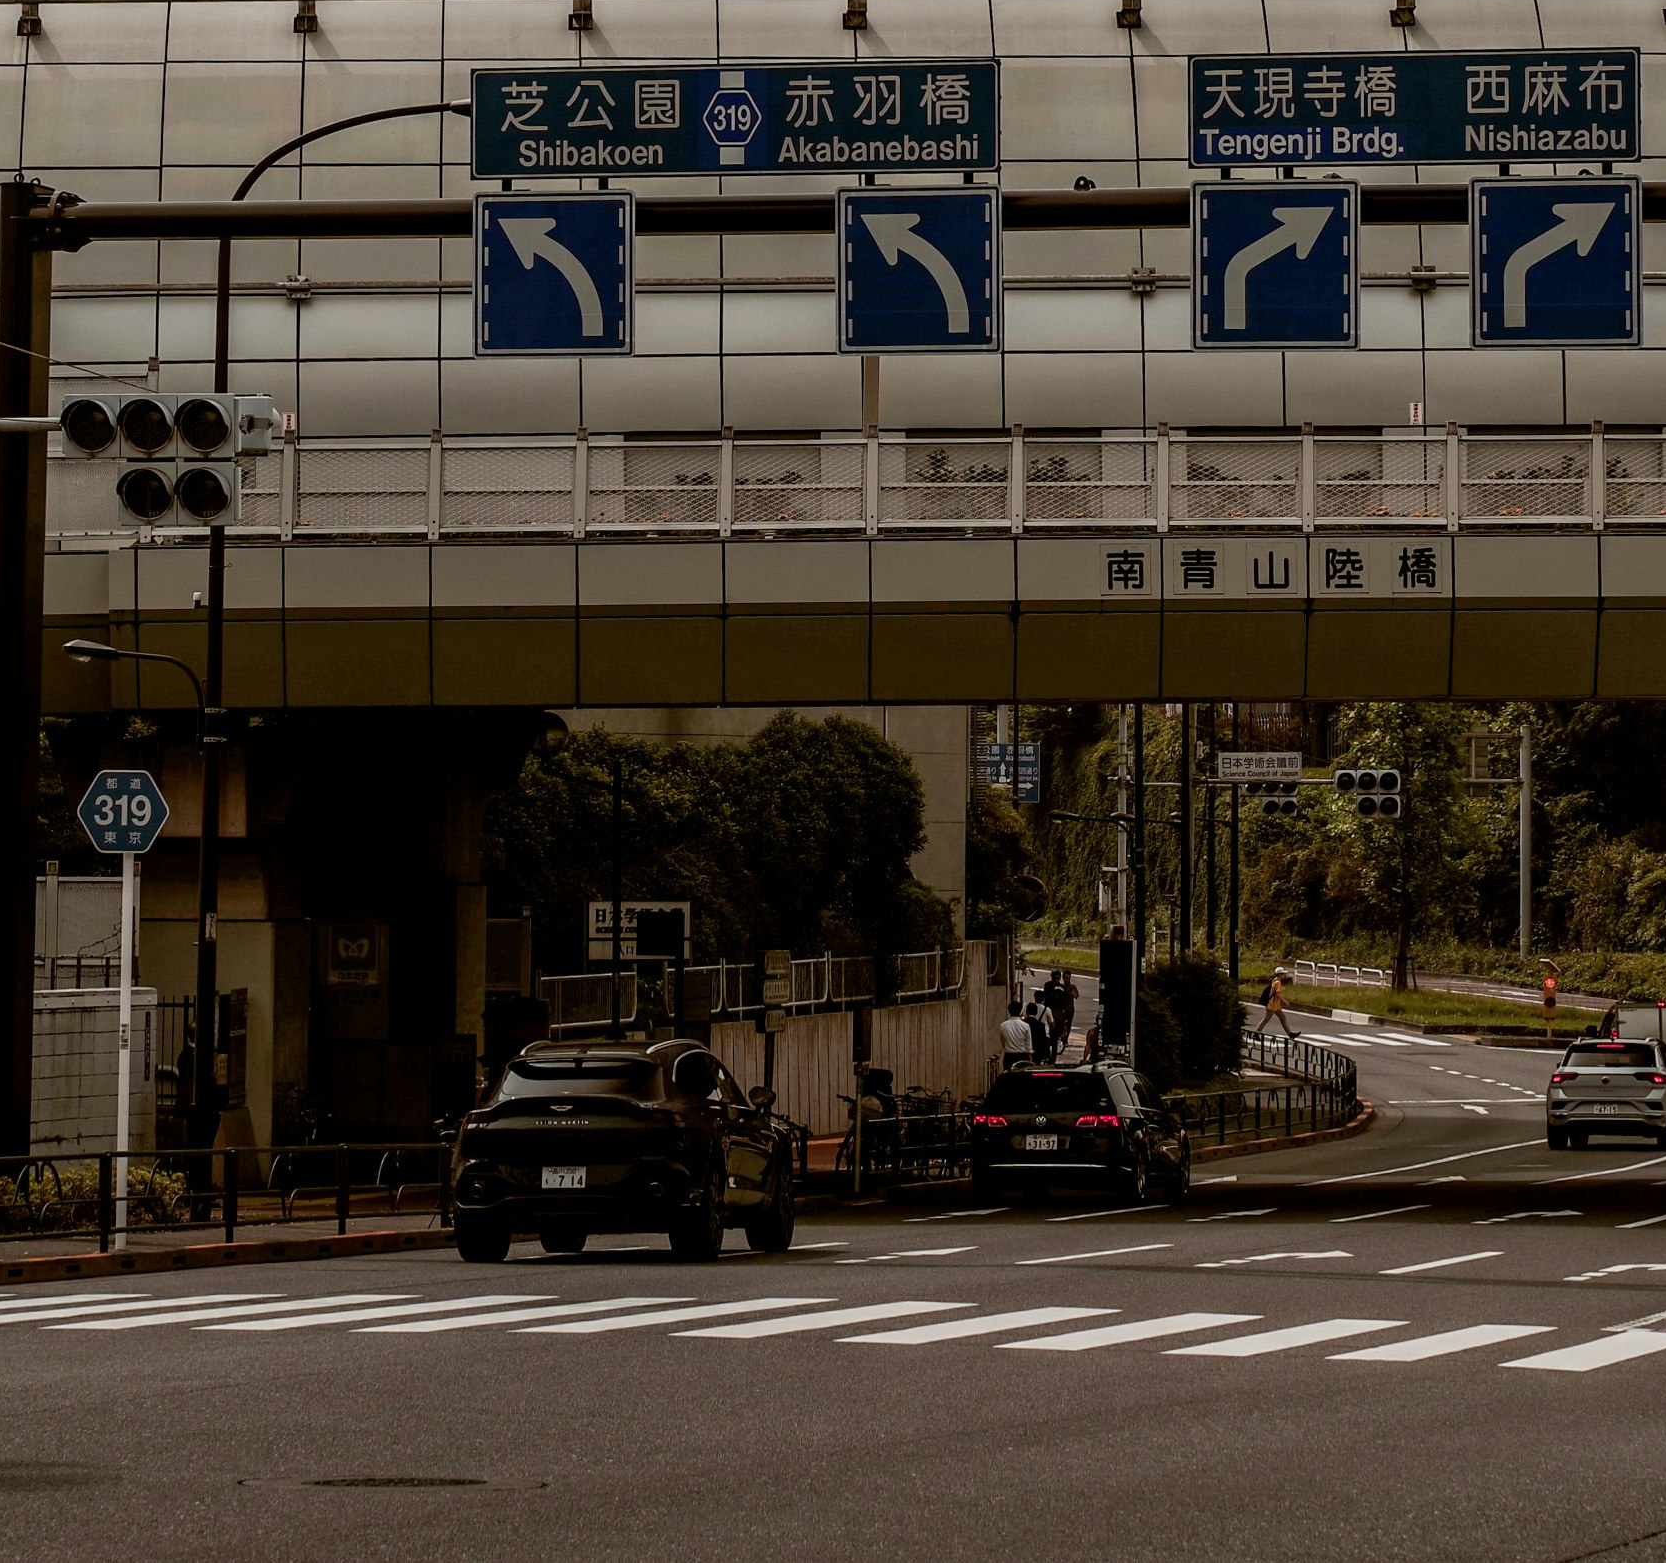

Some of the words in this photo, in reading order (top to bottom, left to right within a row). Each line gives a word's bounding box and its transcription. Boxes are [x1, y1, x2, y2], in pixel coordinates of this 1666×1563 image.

[786, 73, 971, 127] 赤羽橋
[1203, 65, 1396, 118] 天現寺橋
[1465, 60, 1626, 115] 西麻布
[501, 80, 680, 132] 芝公園
[714, 103, 751, 130] 319
[519, 140, 663, 167] Shibakoen
[778, 134, 978, 163] Akabanebashi
[1200, 127, 1322, 160] Tengenji
[1333, 125, 1404, 158] Brdg.
[1465, 123, 1626, 152] Nishiazabu
[1106, 547, 1437, 590] 南青山陸橋
[1222, 757, 1299, 769] 日本学術会議前
[106, 778, 141, 790] 都道
[94, 795, 151, 826] 319
[104, 831, 141, 844] 東京
